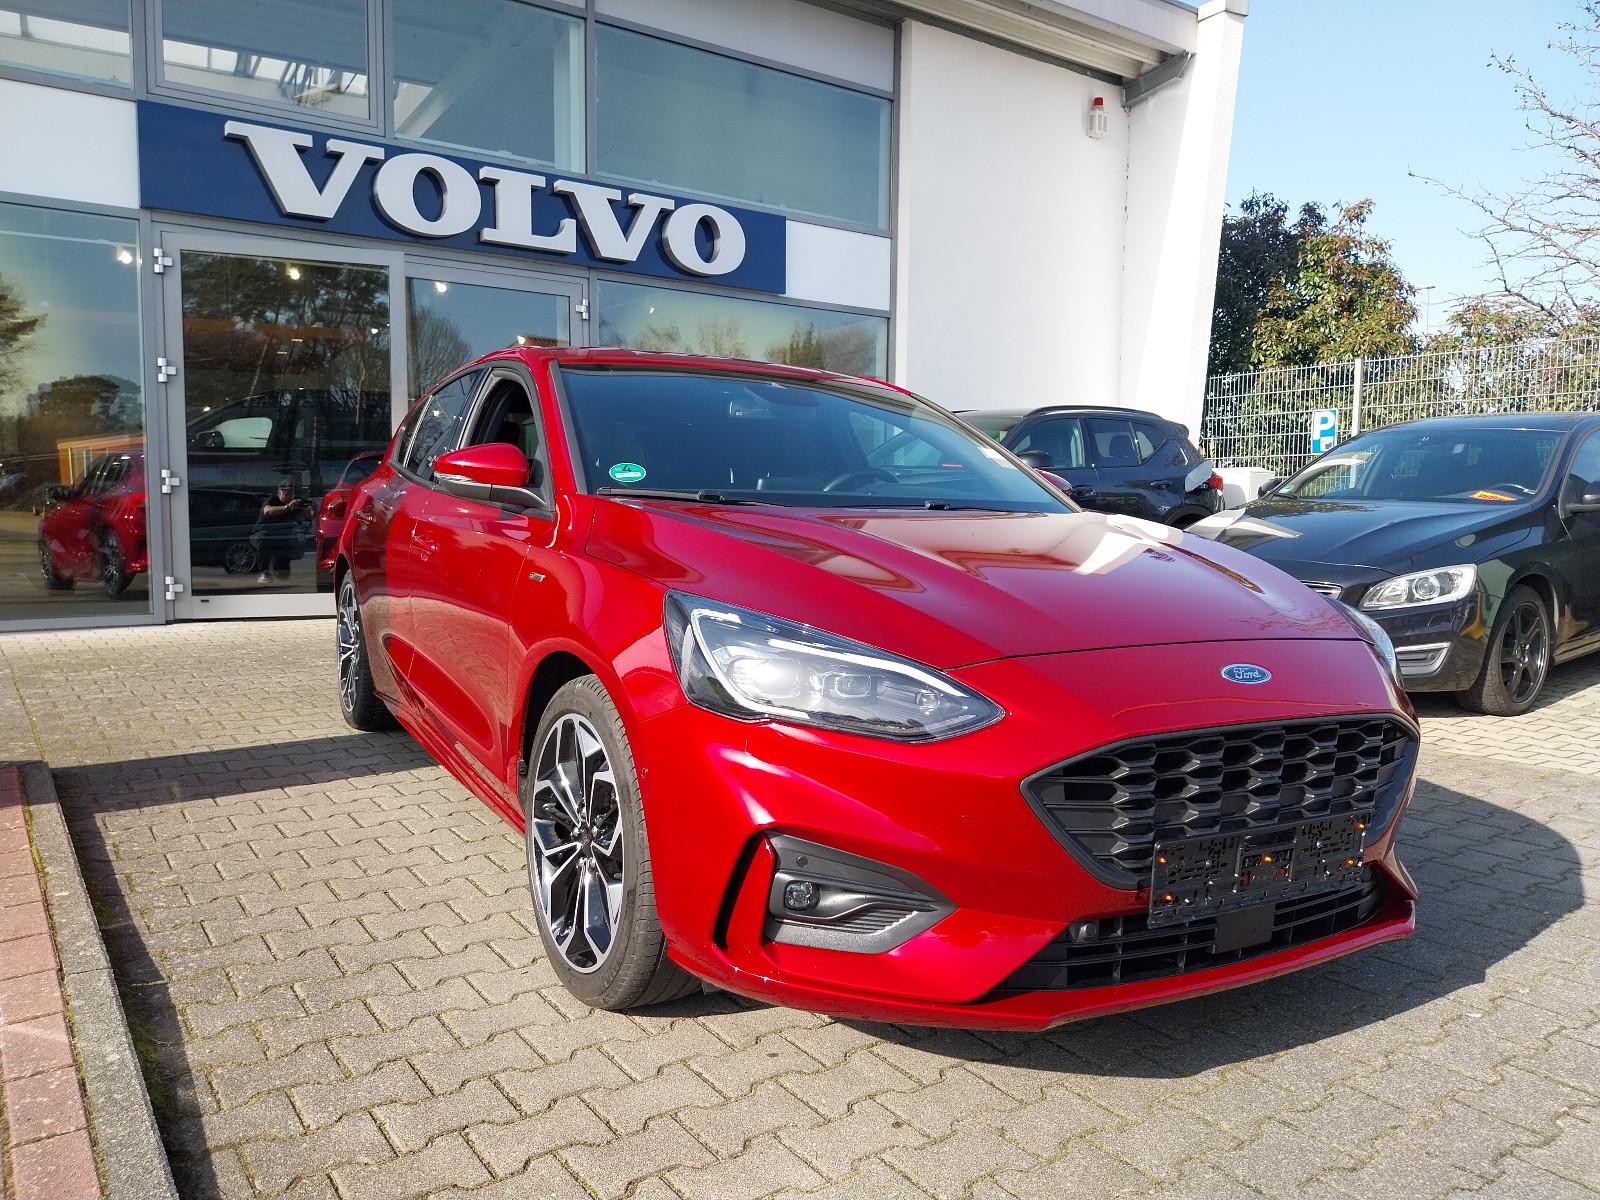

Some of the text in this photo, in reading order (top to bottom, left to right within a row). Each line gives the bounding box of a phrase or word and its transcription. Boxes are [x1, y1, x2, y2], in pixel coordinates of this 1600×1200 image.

[224, 120, 746, 275] VOLVO
[1313, 410, 1336, 440] P
[1233, 667, 1262, 680] Ford
